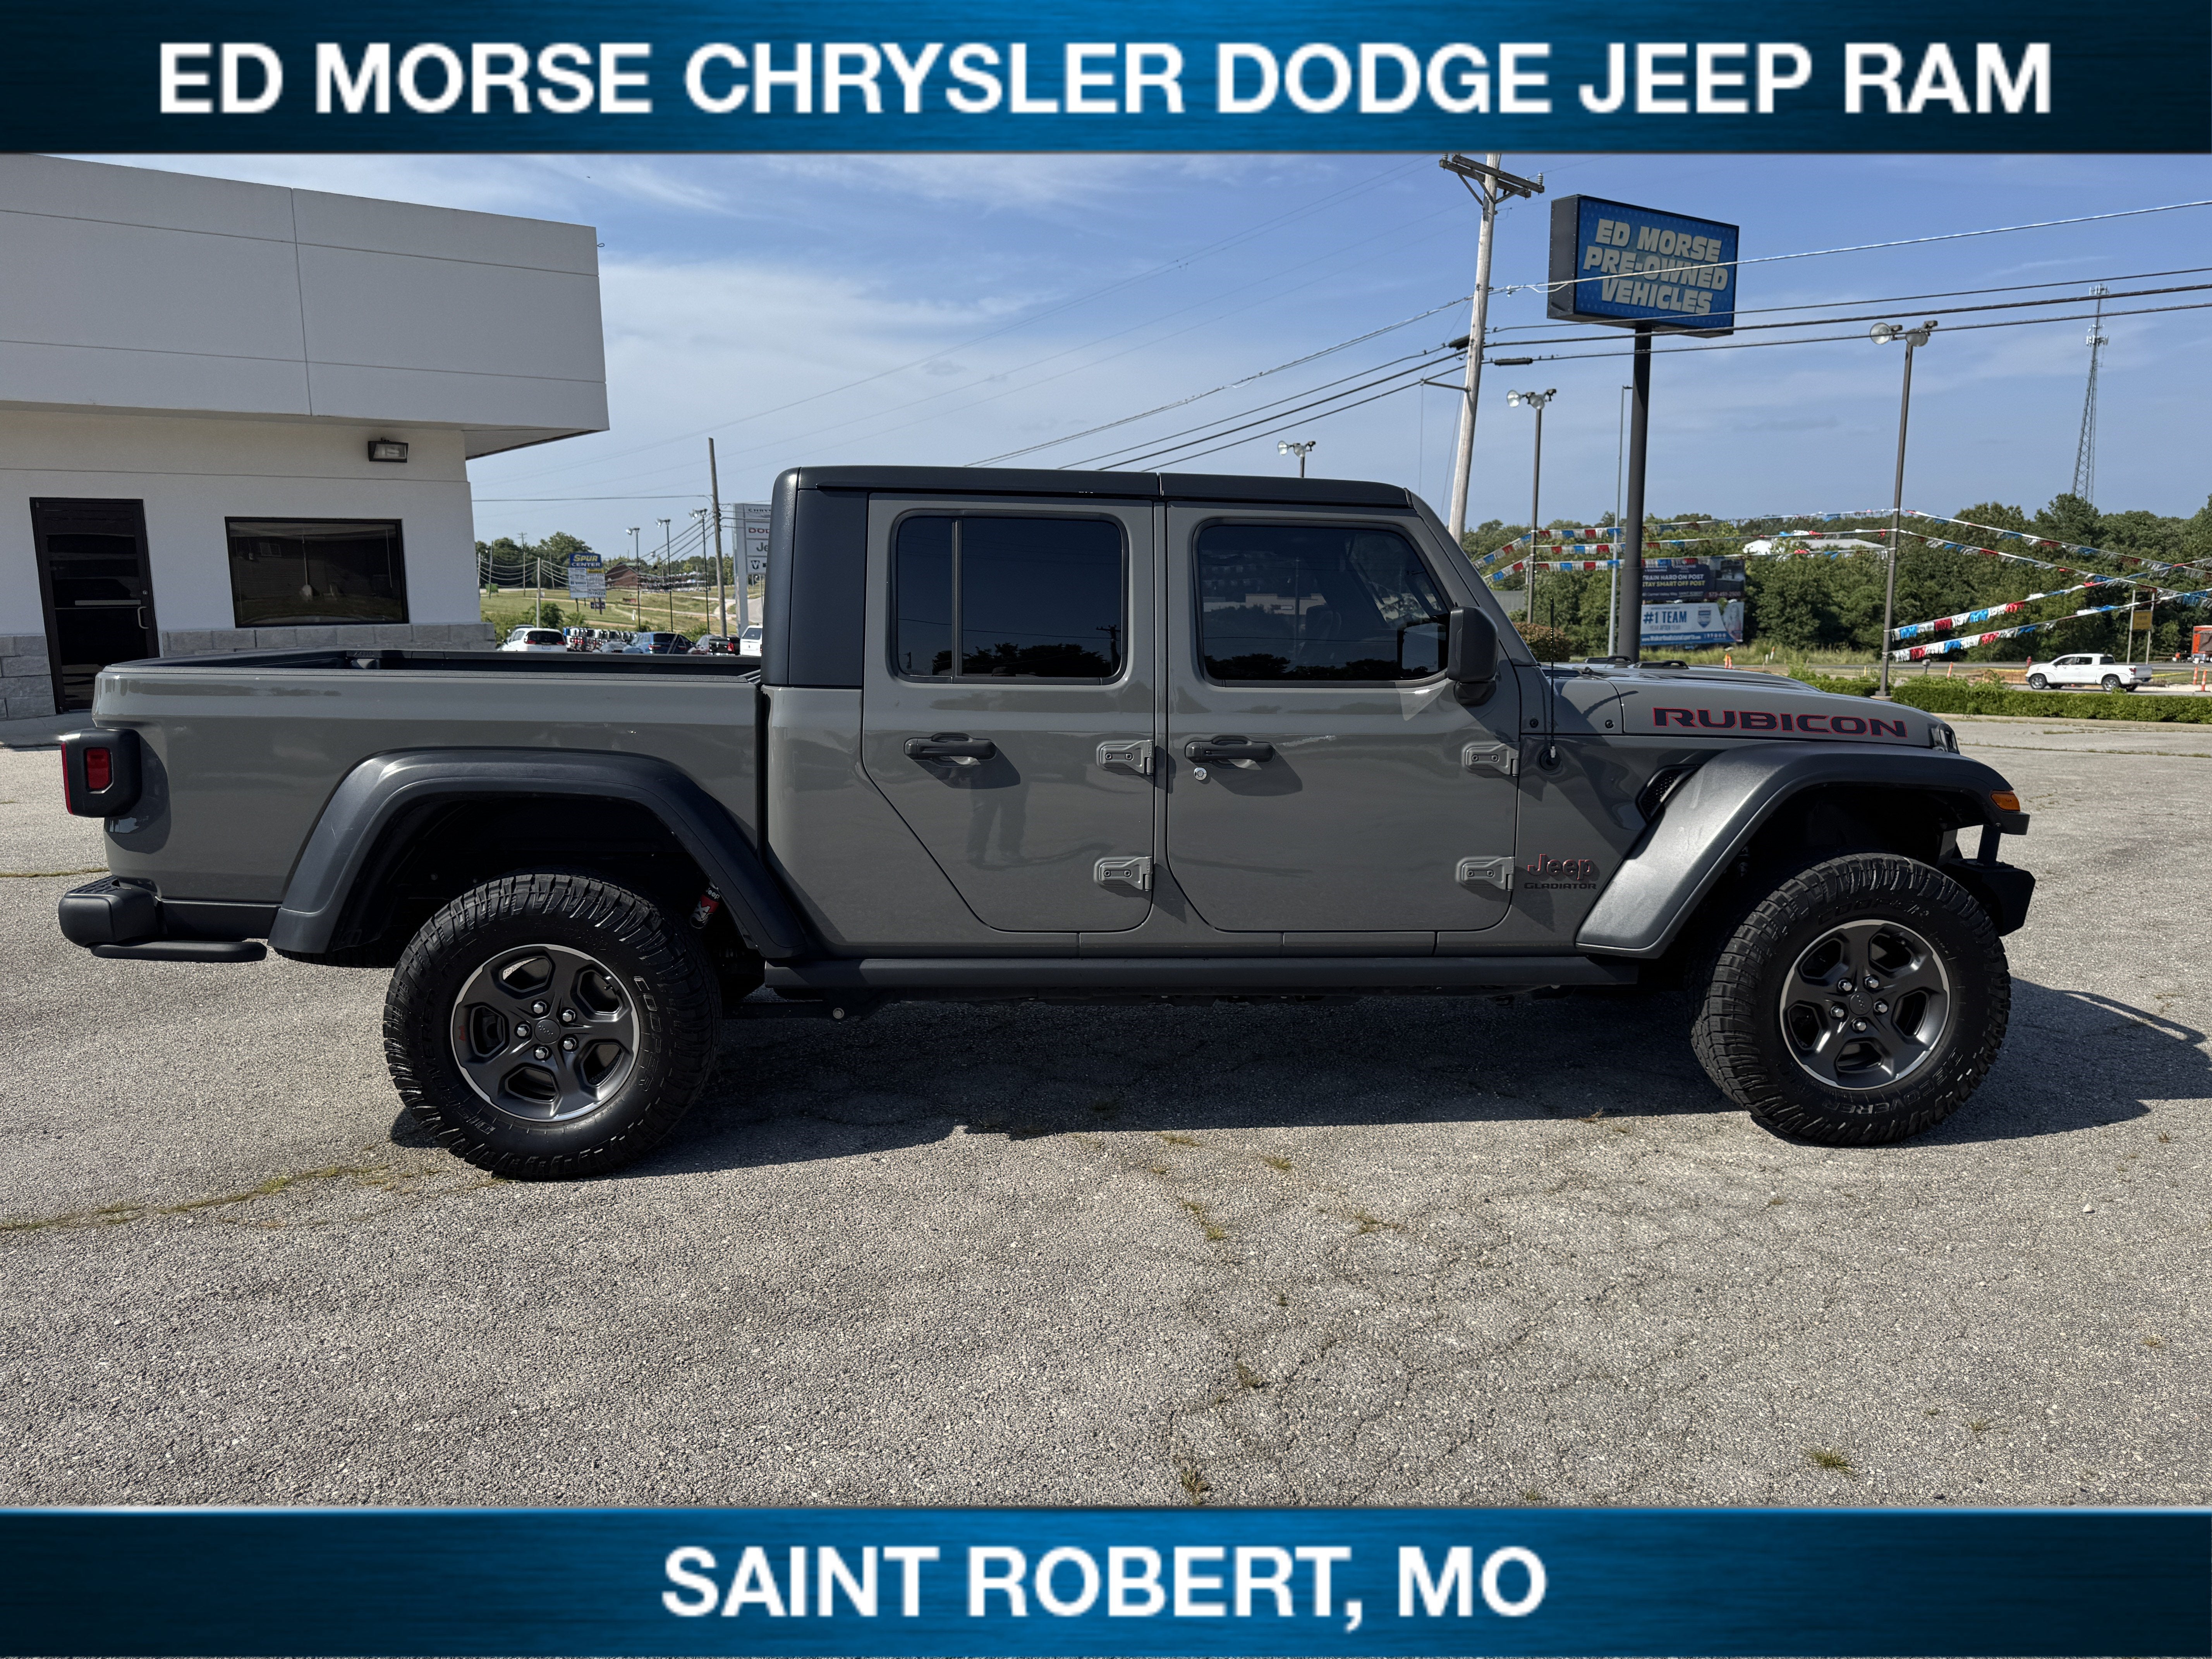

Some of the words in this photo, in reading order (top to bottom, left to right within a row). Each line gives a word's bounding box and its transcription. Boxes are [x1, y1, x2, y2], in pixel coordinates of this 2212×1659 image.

[1595, 218, 1630, 247] ED
[1636, 226, 1722, 263] MORSE
[1583, 246, 1728, 291] PRE-OWNED
[1602, 278, 1713, 314] VEHICLES
[574, 554, 598, 562] SPUR
[1643, 611, 1658, 624] #1
[1662, 611, 1687, 623] TEAM
[1652, 707, 1908, 739] RUBICON
[1527, 854, 1594, 880] Jeep
[706, 887, 720, 900] Jeep
